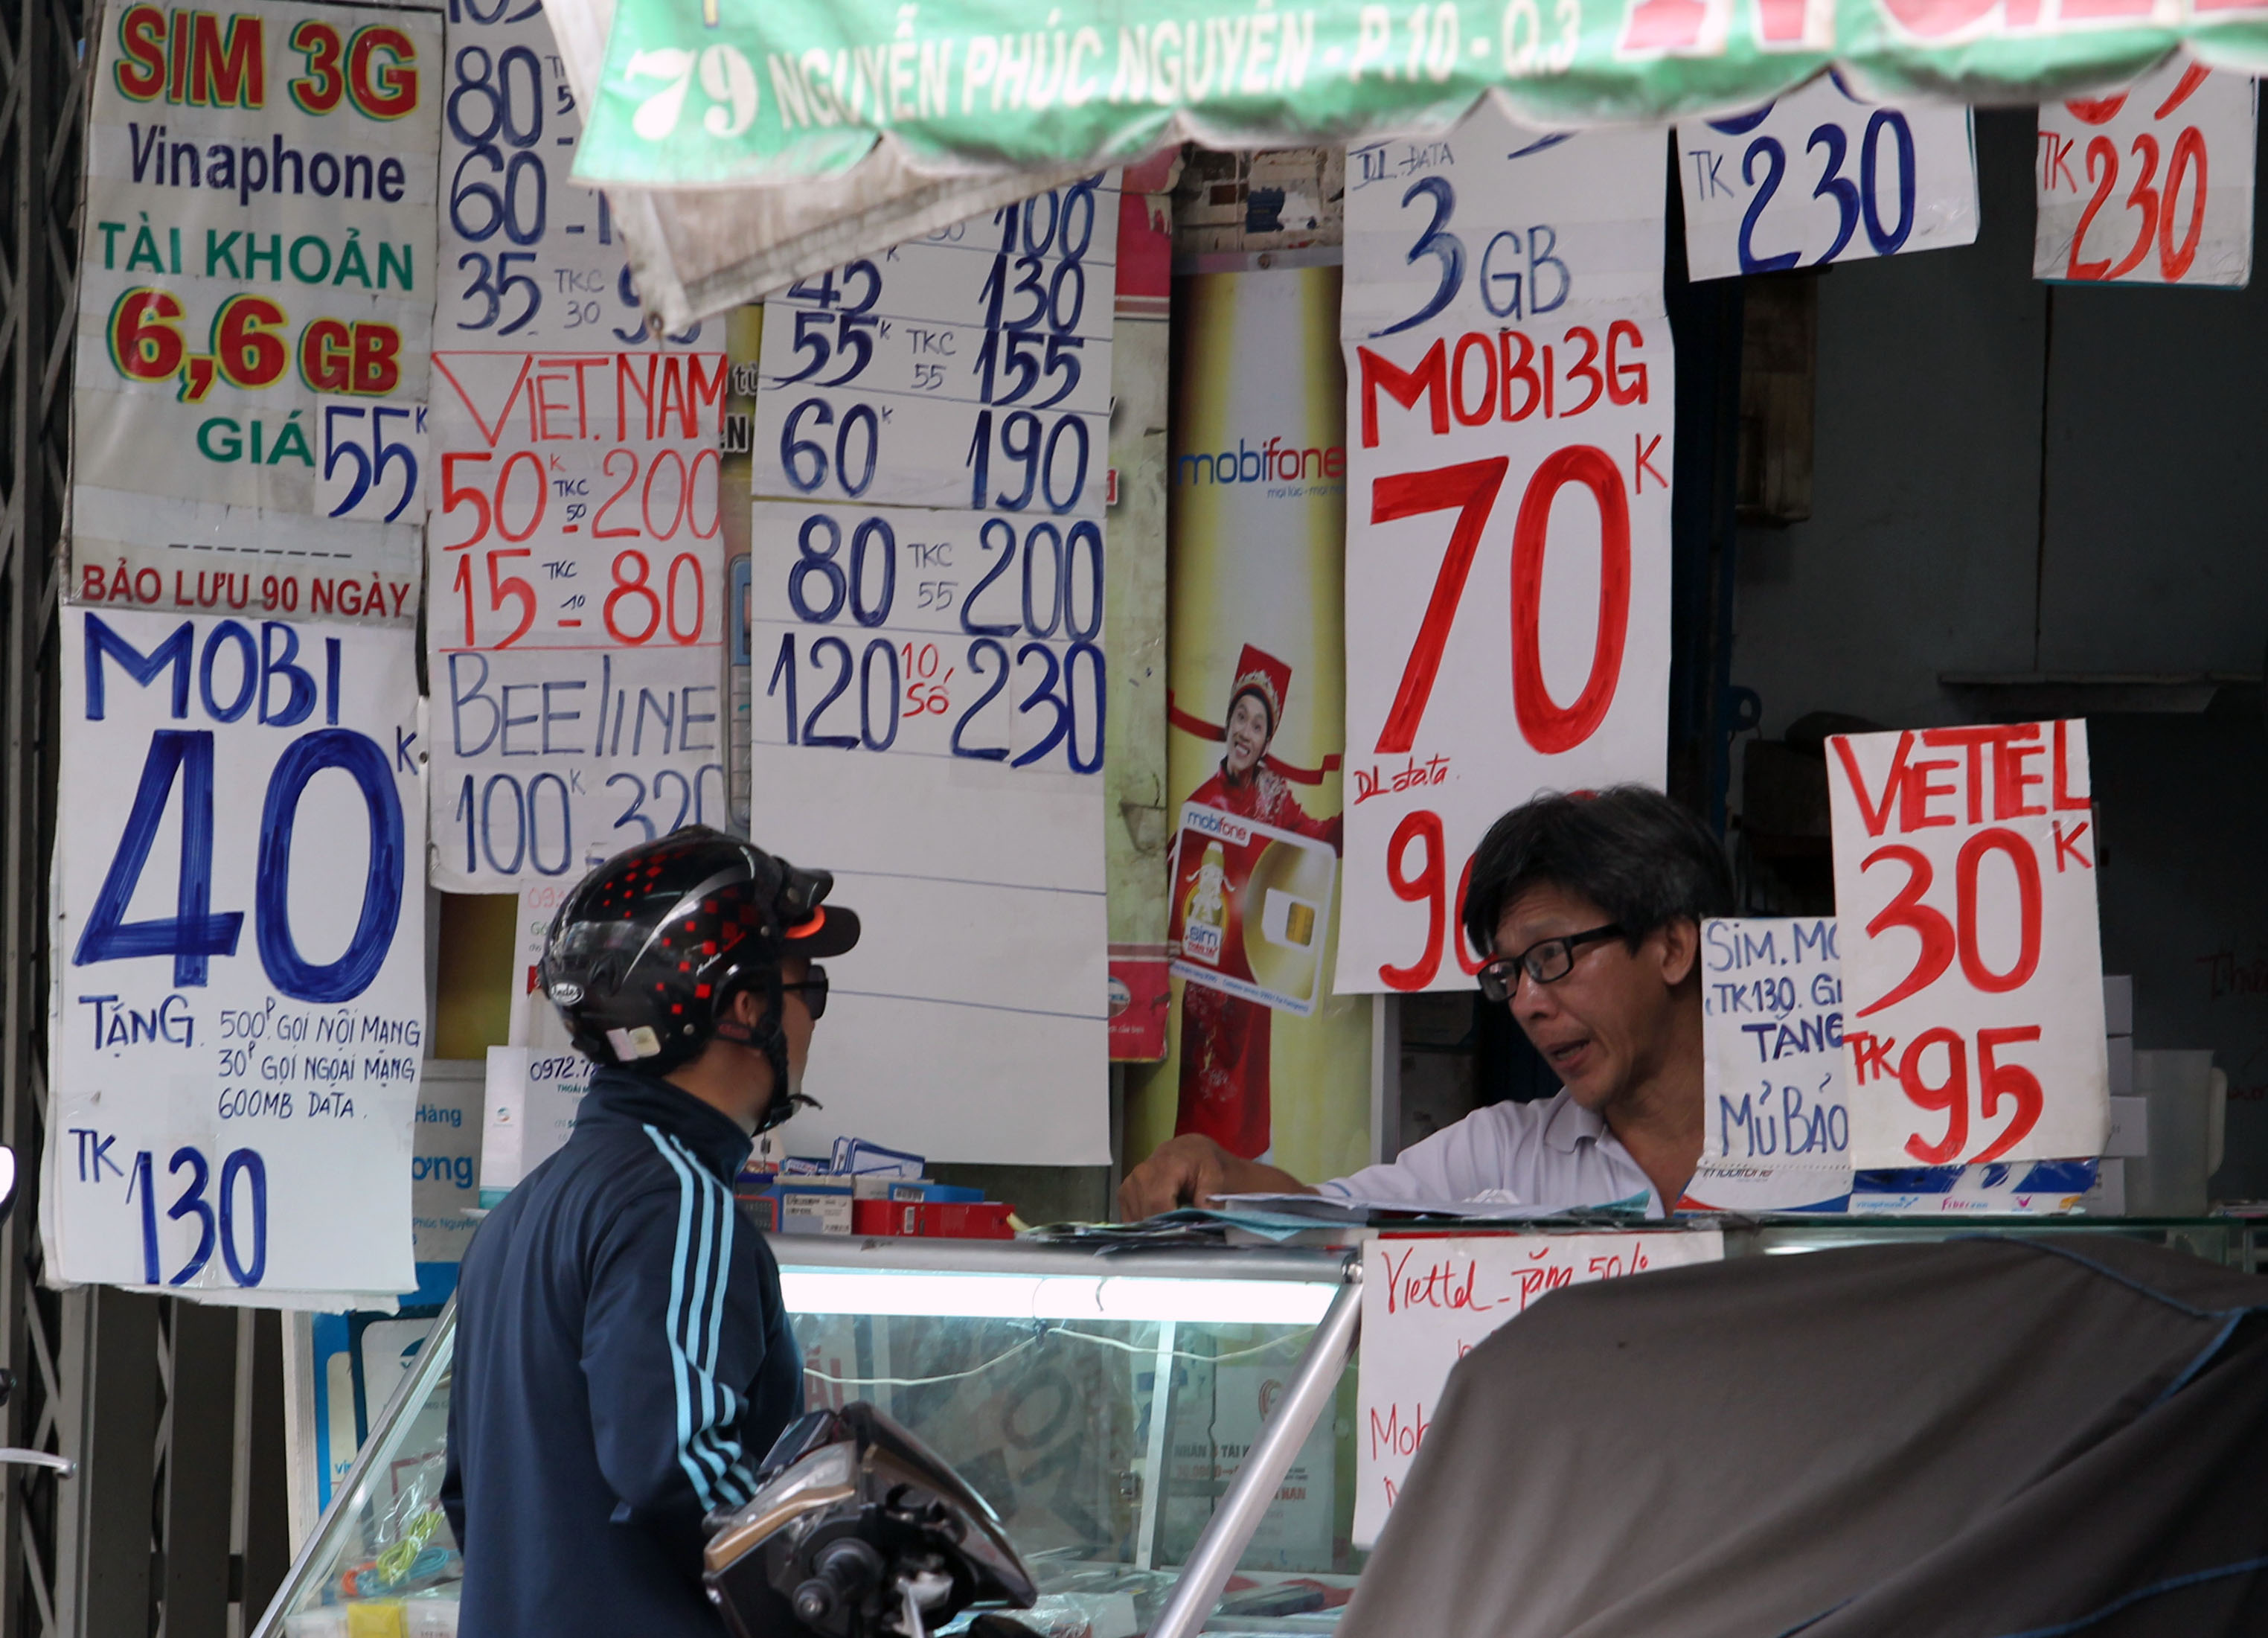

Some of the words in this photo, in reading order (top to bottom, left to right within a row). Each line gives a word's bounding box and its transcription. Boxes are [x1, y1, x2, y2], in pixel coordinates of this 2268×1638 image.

[114, 3, 267, 110] SIM
[289, 19, 421, 120] 3G
[446, 45, 542, 147] 80
[624, 44, 757, 139] 79
[960, 7, 1103, 115] PHÚC
[129, 122, 406, 205] Vinaphone
[449, 143, 547, 246] 60
[1688, 151, 1734, 199] TK
[1737, 109, 1915, 275] 230
[2037, 130, 2078, 193] TK
[2066, 125, 2208, 283] 230
[97, 211, 181, 275] TÀI
[205, 227, 414, 291] KHOẢN
[1368, 176, 1467, 338] 3
[1480, 225, 1570, 321] GB
[457, 252, 542, 336] 35
[554, 269, 604, 293] TKC
[564, 301, 600, 328] 30
[978, 254, 1084, 336] 130
[106, 287, 291, 405] 6,6
[298, 316, 401, 397] GB
[906, 328, 955, 355] TKC
[973, 330, 1084, 409] 155
[911, 363, 946, 390] 55
[196, 410, 314, 467] GIÁ
[966, 410, 1089, 515] 190
[1177, 435, 1346, 484] mobifone
[553, 479, 589, 498] TKC
[566, 505, 586, 521] 50
[592, 448, 721, 541] 200
[82, 558, 161, 604] BẢO
[175, 571, 250, 610] LƯU
[261, 577, 298, 611] 90
[311, 571, 411, 618] NGÀY
[453, 548, 536, 650] 15
[542, 562, 577, 580] TKC
[603, 548, 704, 646] 80
[788, 514, 896, 627] 80
[907, 543, 952, 569] TKC
[960, 517, 1103, 642] 200
[917, 581, 958, 611] 55
[84, 612, 341, 726] MOBI
[766, 633, 900, 752] 120
[951, 638, 1106, 774] 230
[1830, 720, 2092, 837] VIETTEL
[1188, 811, 1246, 840] mobifone
[361, 1015, 421, 1053] MẠNG
[364, 1057, 415, 1087] MẠNG
[219, 1087, 292, 1119] 600MB
[1842, 1031, 1899, 1086] TK
[1898, 1025, 2044, 1165] 95
[68, 1129, 124, 1183] TK
[126, 1146, 267, 1287] 130
[1382, 1247, 1492, 1314] Viettel
